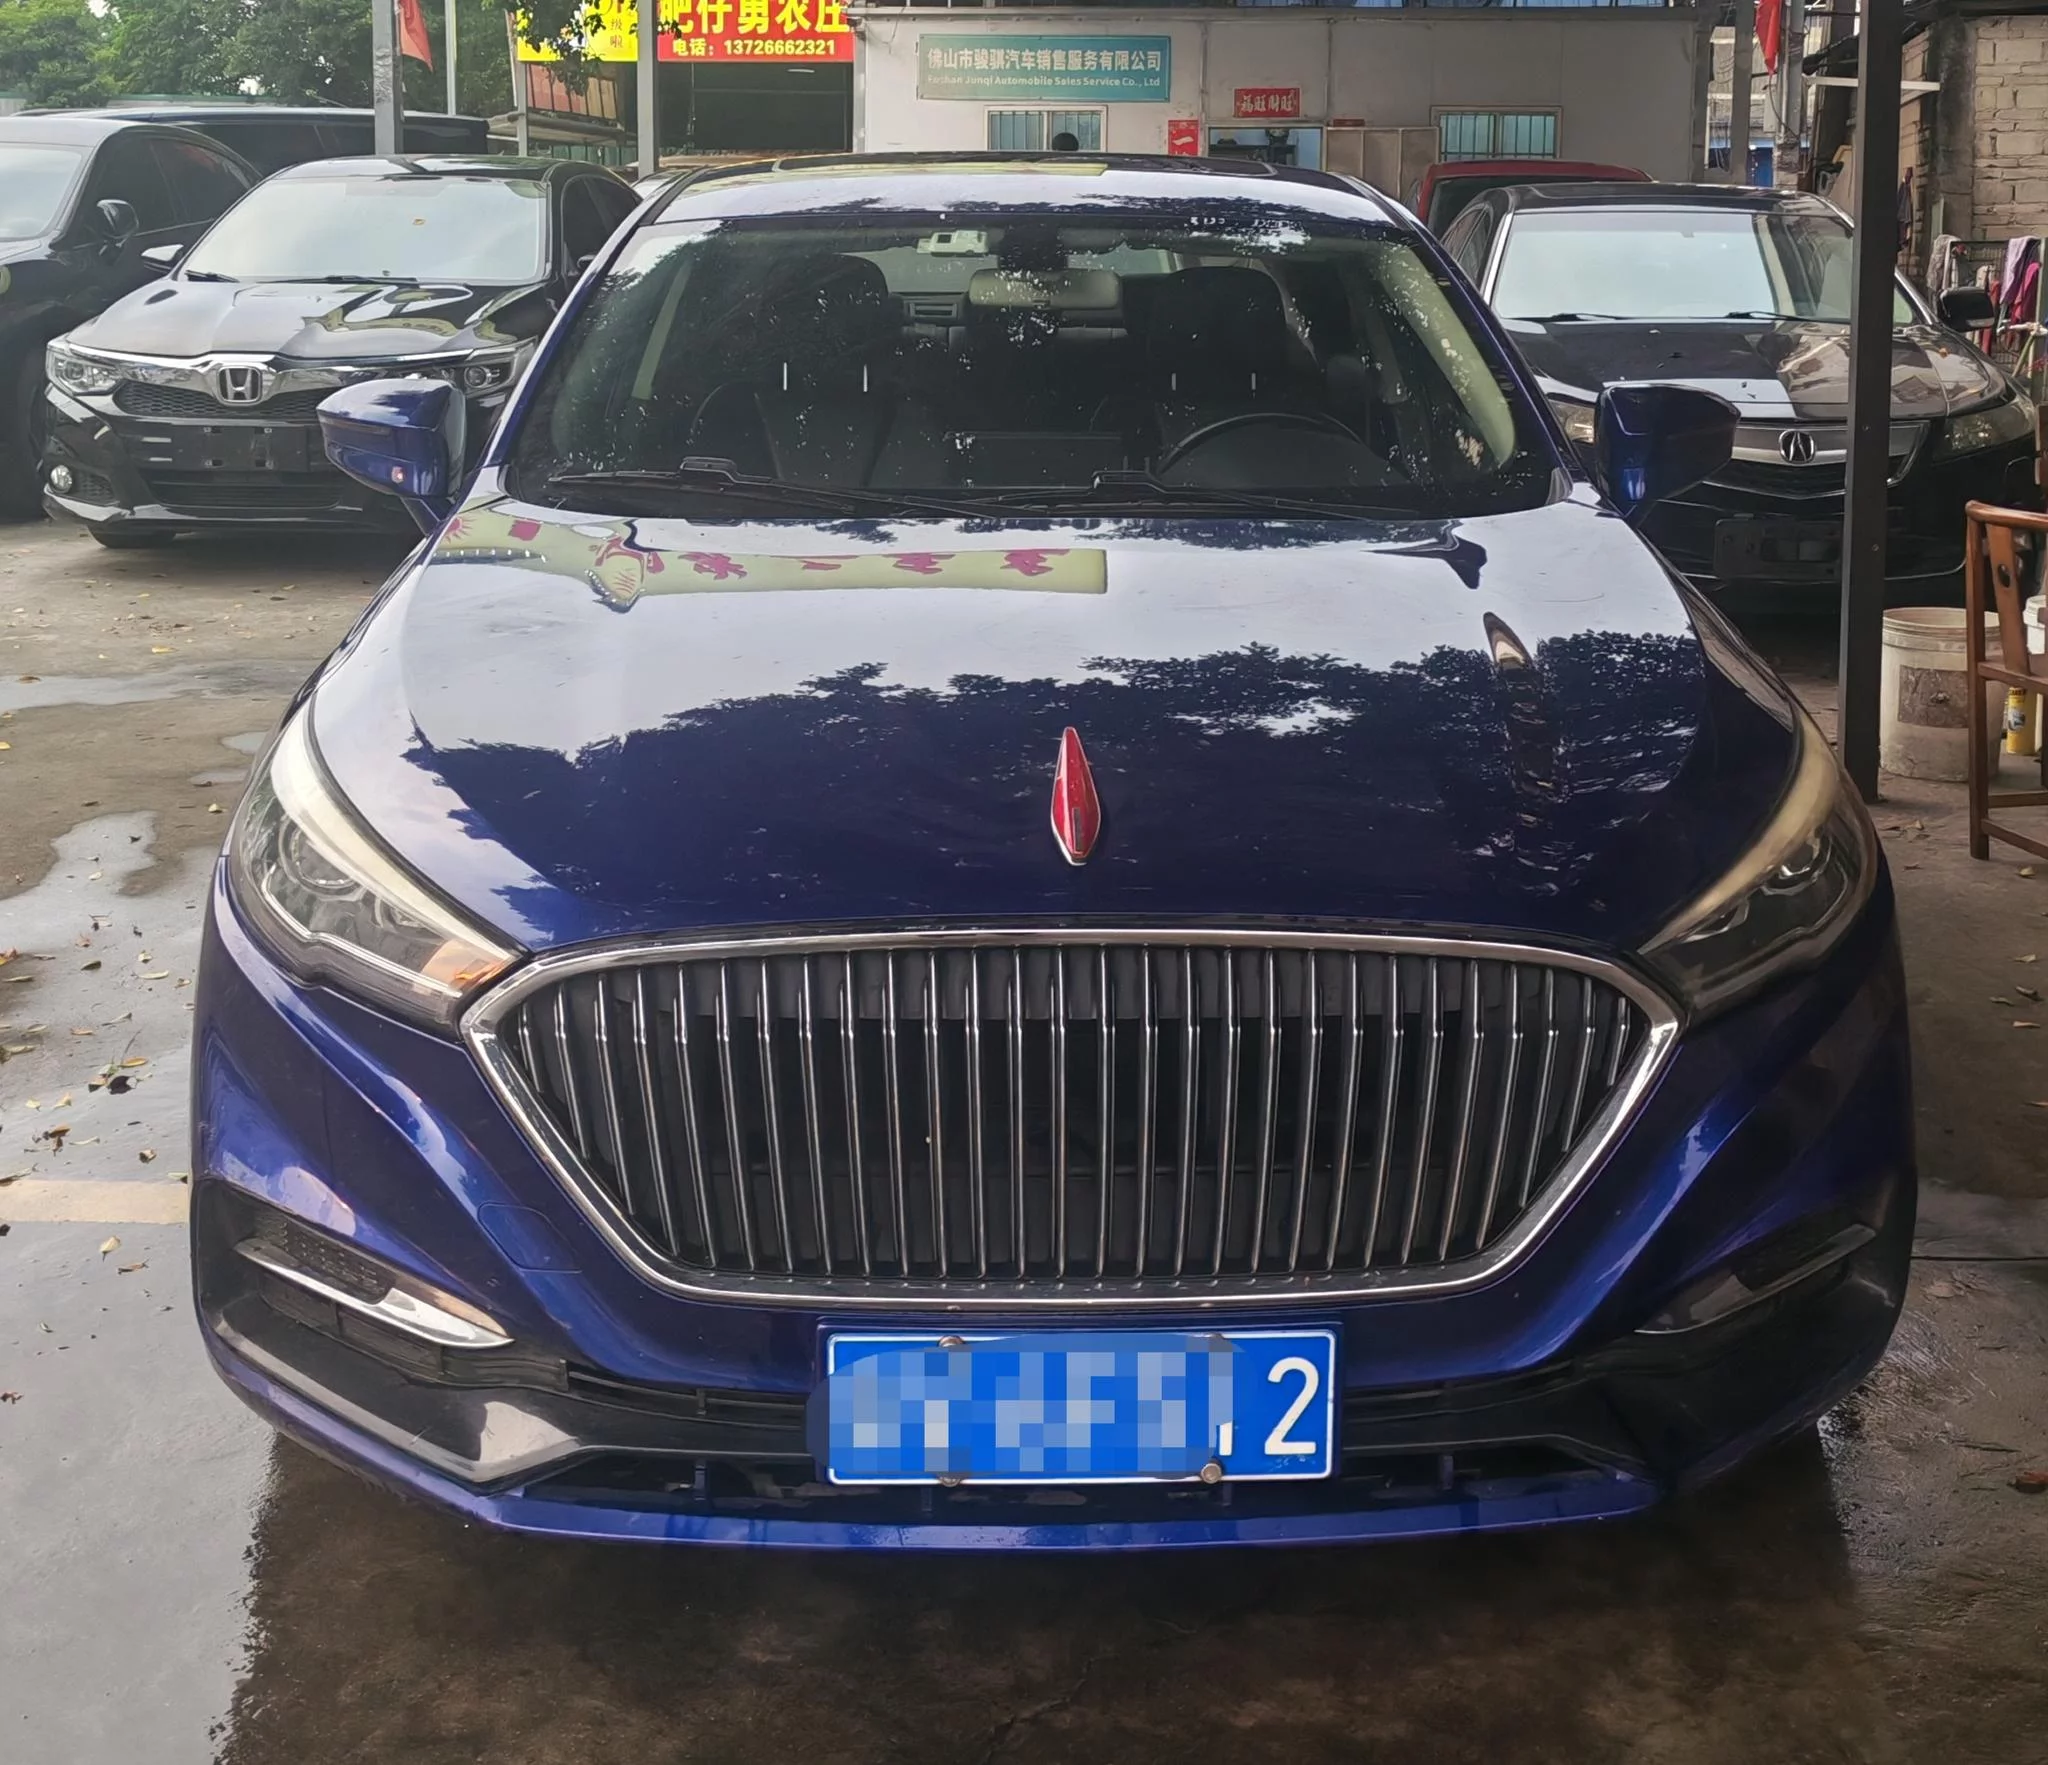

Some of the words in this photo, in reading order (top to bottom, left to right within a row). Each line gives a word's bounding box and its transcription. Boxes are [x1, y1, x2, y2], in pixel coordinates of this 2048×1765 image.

[965, 75, 993, 87] Junqi
[995, 75, 1053, 87] Automobile
[1055, 76, 1081, 86] Sales
[1083, 76, 1120, 87] Service
[1144, 77, 1160, 87] Ltd
